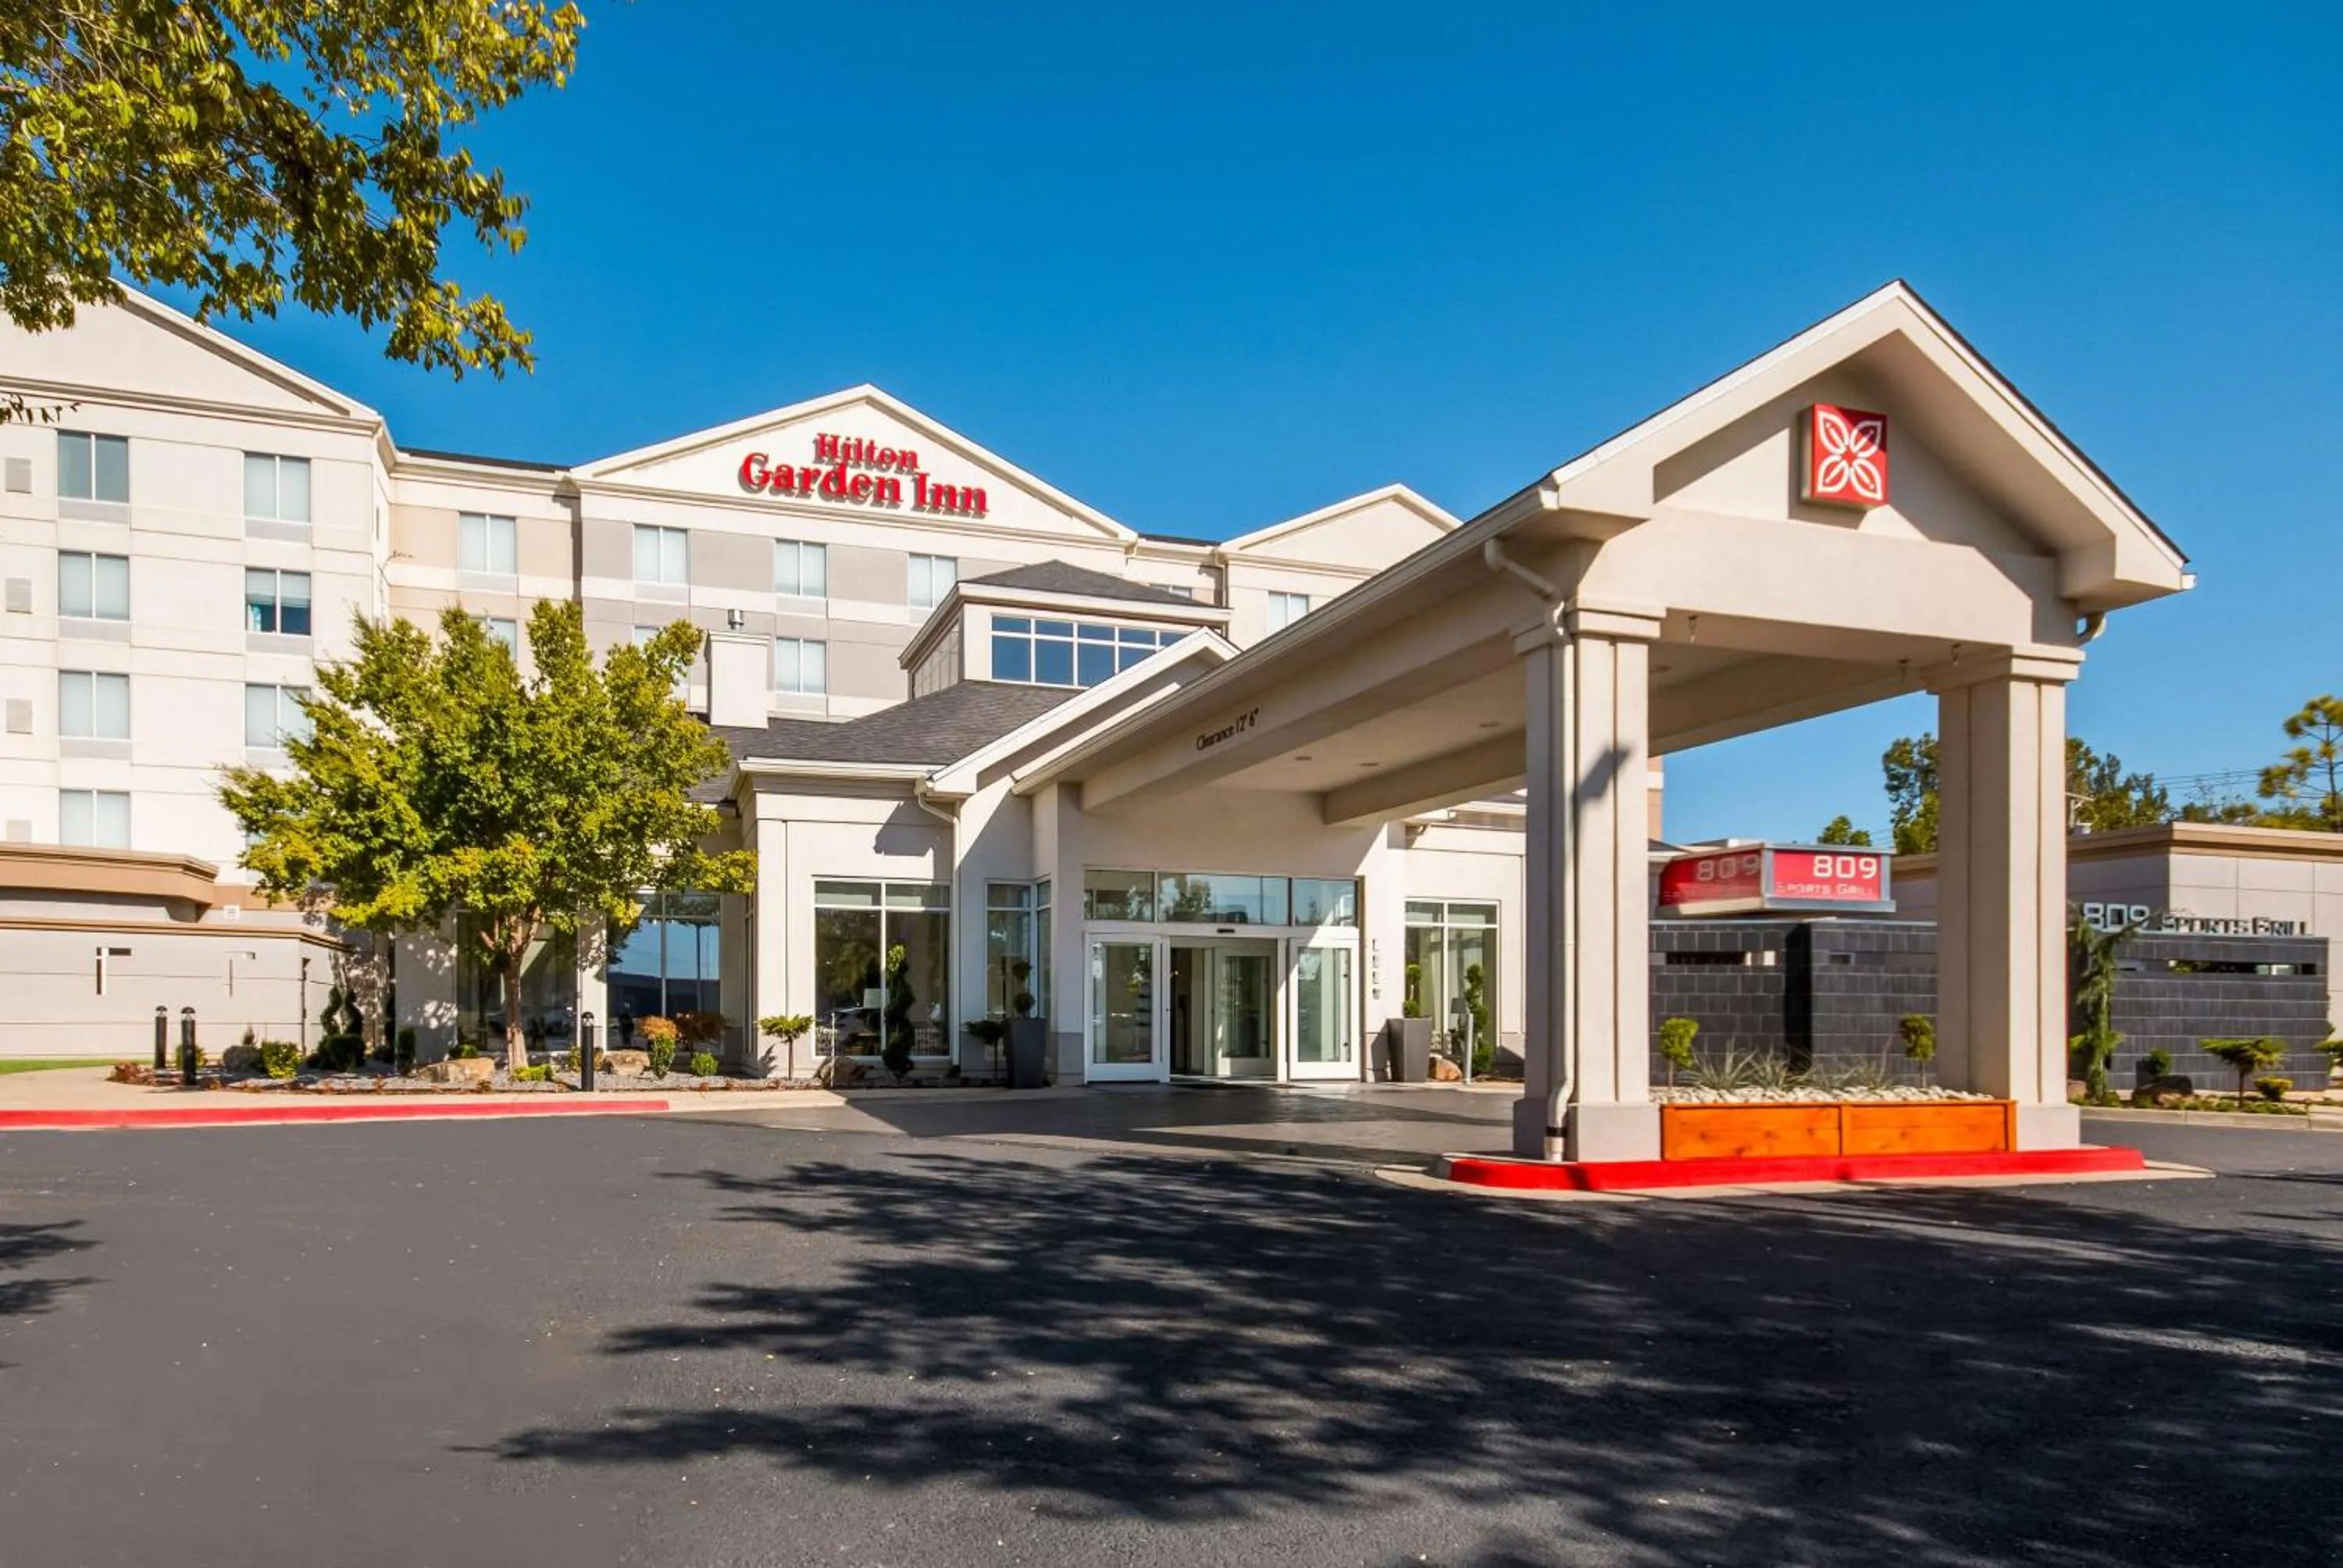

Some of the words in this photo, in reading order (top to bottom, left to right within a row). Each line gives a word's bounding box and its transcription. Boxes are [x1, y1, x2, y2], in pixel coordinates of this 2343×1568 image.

[815, 432, 920, 470] Hilton
[740, 452, 904, 503] Garden
[915, 472, 990, 513] Inn
[1196, 725, 1235, 750] Clearance
[1696, 854, 1760, 882] 809
[1812, 854, 1878, 880] 809
[2082, 902, 2150, 931] 809
